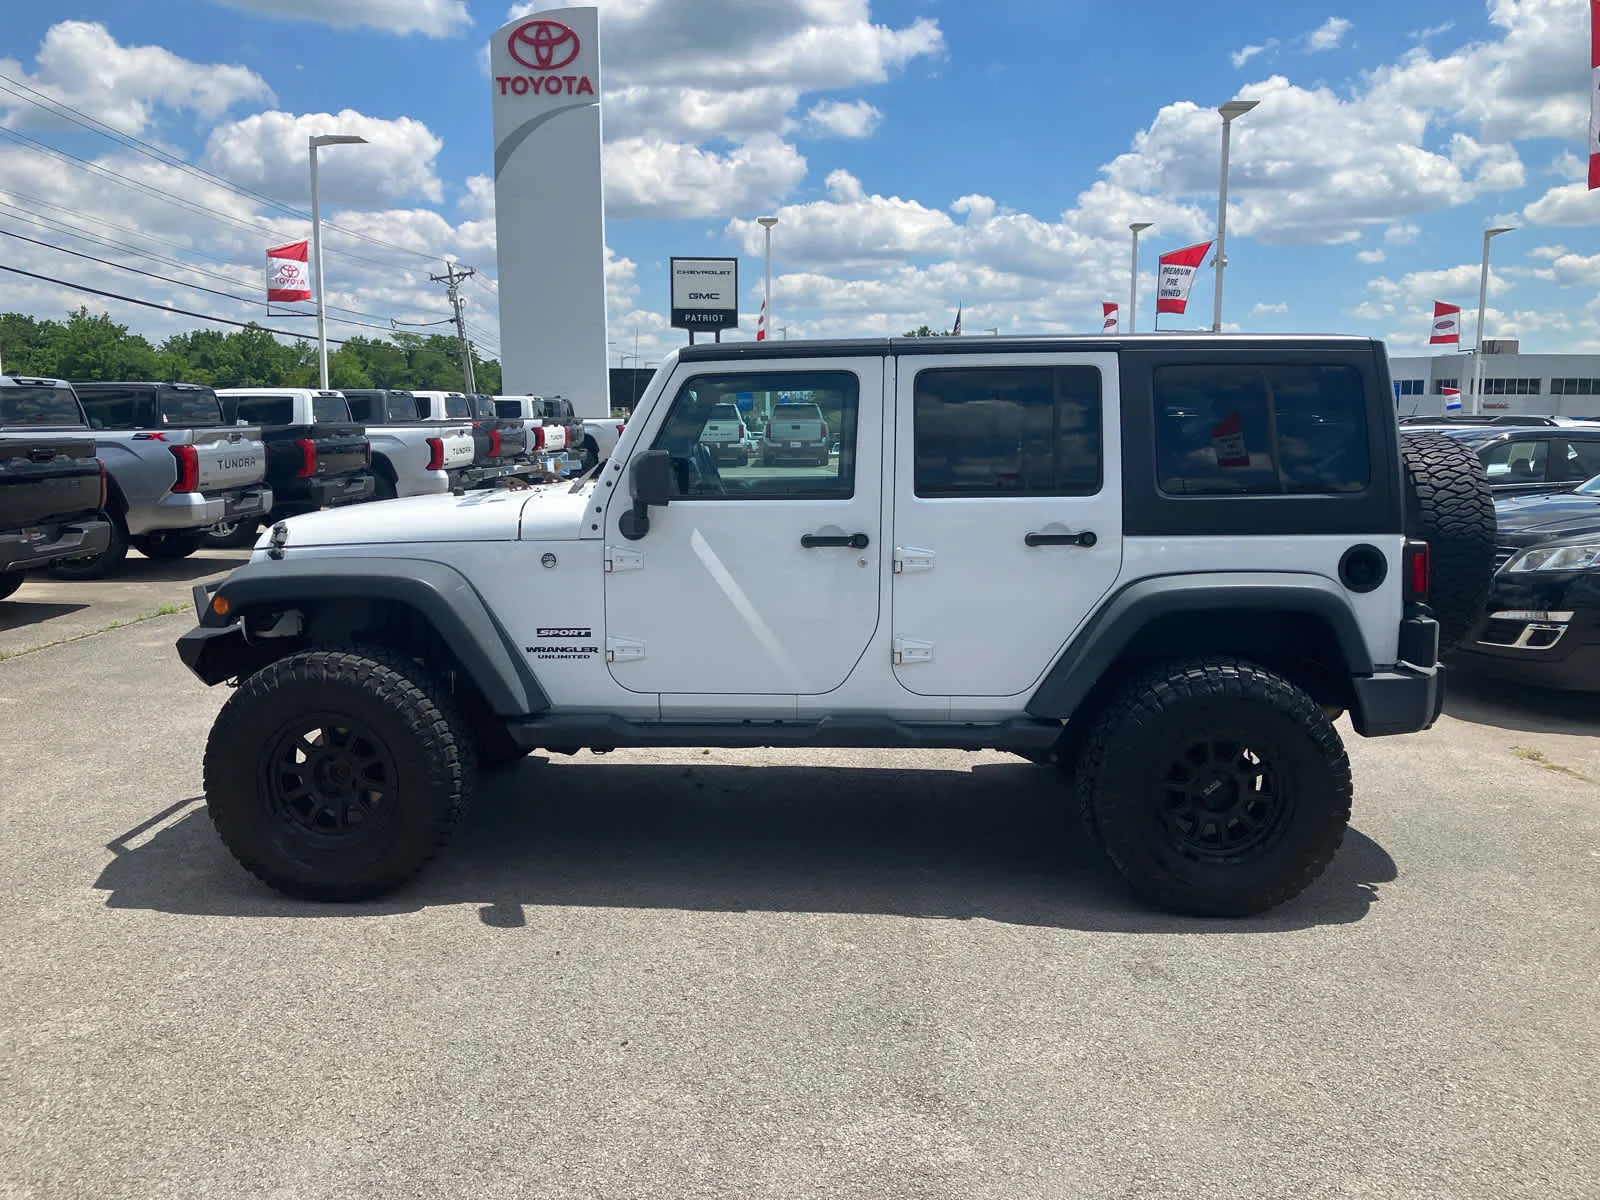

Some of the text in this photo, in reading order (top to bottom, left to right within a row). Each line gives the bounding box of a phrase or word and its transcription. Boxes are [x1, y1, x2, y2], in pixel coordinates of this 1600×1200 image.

[496, 76, 594, 95] TOYOTA
[1162, 266, 1192, 276] PREMIUM
[274, 277, 305, 285] TOYOTA
[1166, 278, 1179, 286] PRE
[688, 292, 721, 300] GMC
[1160, 289, 1180, 297] OWNED
[685, 313, 724, 322] PATRIOT
[217, 456, 256, 470] TUNDRA
[537, 628, 592, 637] SPORT
[525, 646, 599, 654] WRANGLER
